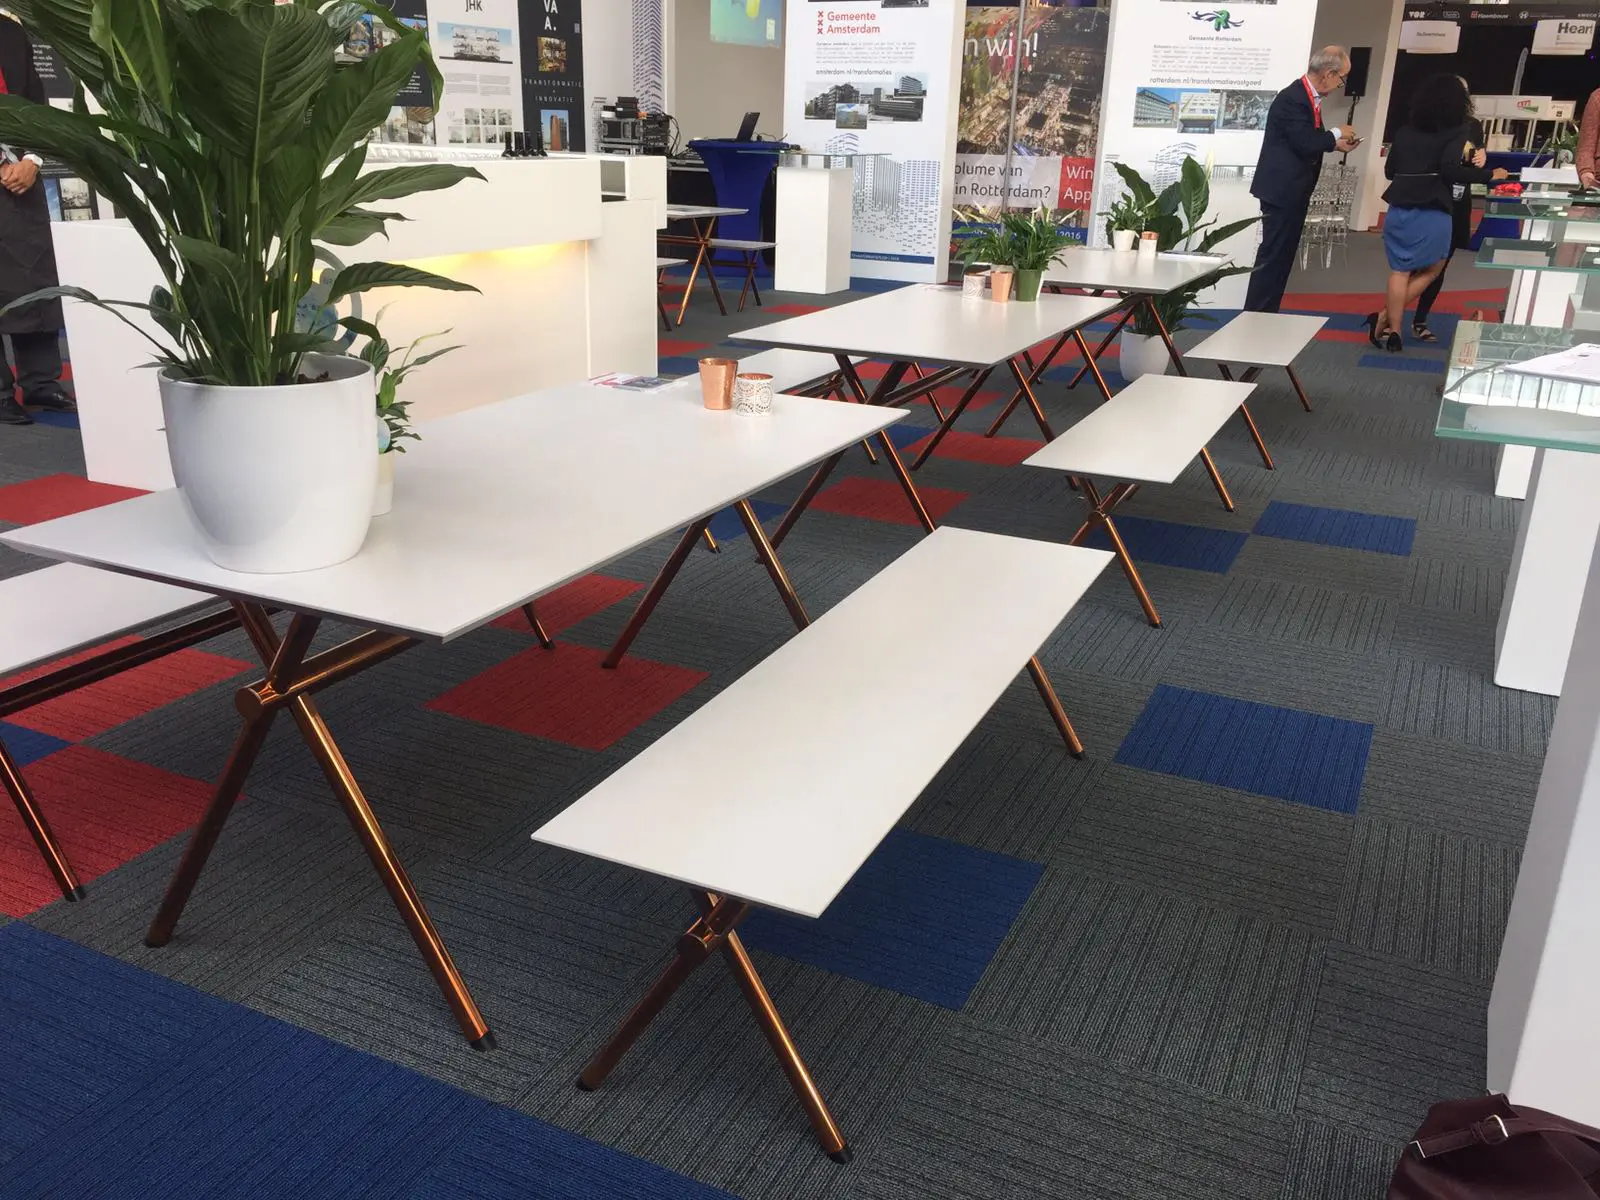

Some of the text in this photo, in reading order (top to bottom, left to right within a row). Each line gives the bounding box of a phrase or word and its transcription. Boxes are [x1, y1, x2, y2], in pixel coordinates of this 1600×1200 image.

[465, 0, 483, 12] JHK
[543, 0, 558, 14] VA
[827, 11, 876, 21] Gemeente
[826, 24, 881, 34] Amsterdam
[986, 31, 1039, 57] win!
[523, 78, 582, 88] TRANSFORMATIE
[535, 95, 574, 103] INNOVATIE
[954, 162, 996, 176] olume
[1066, 165, 1093, 180] Win
[971, 182, 1051, 199] Rotterdam?
[1063, 186, 1092, 204] App
